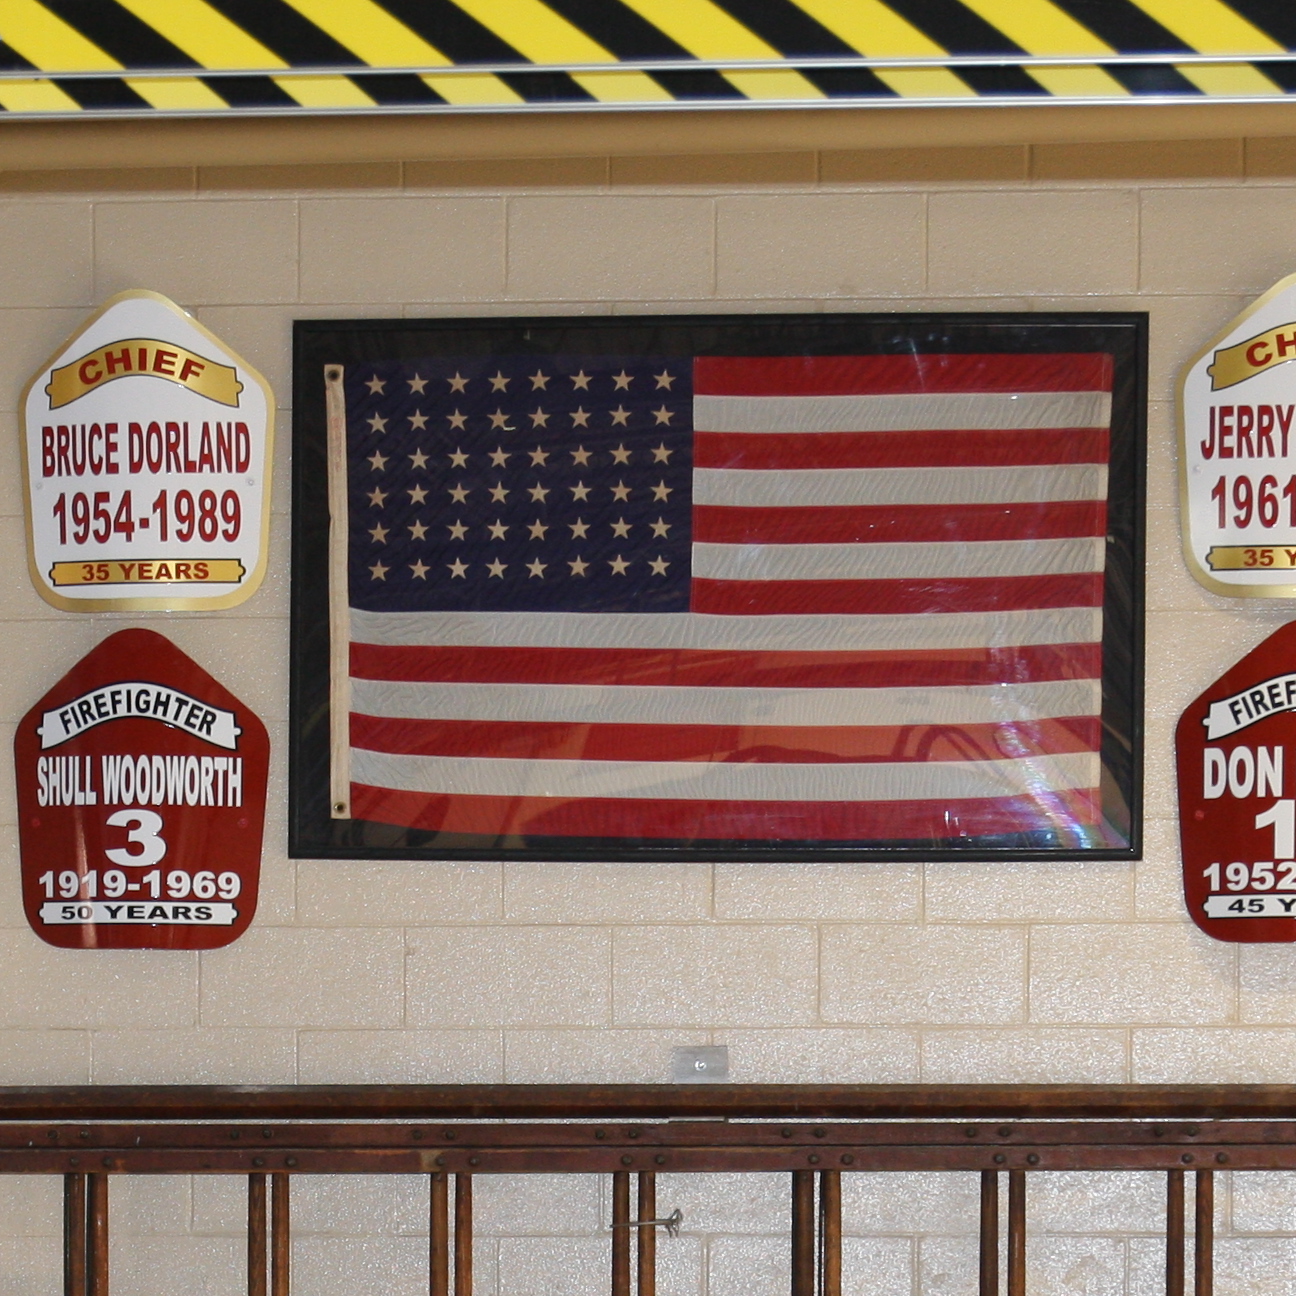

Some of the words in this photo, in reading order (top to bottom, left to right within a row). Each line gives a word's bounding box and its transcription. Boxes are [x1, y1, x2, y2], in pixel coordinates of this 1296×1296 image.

[78, 348, 205, 385] CHIEF
[42, 422, 119, 477] BRUCE
[128, 421, 251, 474] DORLAND
[1200, 404, 1295, 460] JERRY
[53, 489, 241, 545] 1954-1989
[81, 563, 109, 582] 35
[118, 562, 209, 580] YEARS
[1243, 549, 1274, 567] 35
[59, 688, 217, 736] FIREFIGHTER
[37, 755, 96, 806] SHULL
[101, 754, 242, 807] WOODWORTH
[1203, 746, 1284, 800] DON
[104, 808, 167, 867] 3
[38, 870, 241, 899] 1919-1969
[1227, 899, 1265, 914] 45
[61, 905, 93, 920] 50
[104, 905, 213, 919] YEARS
